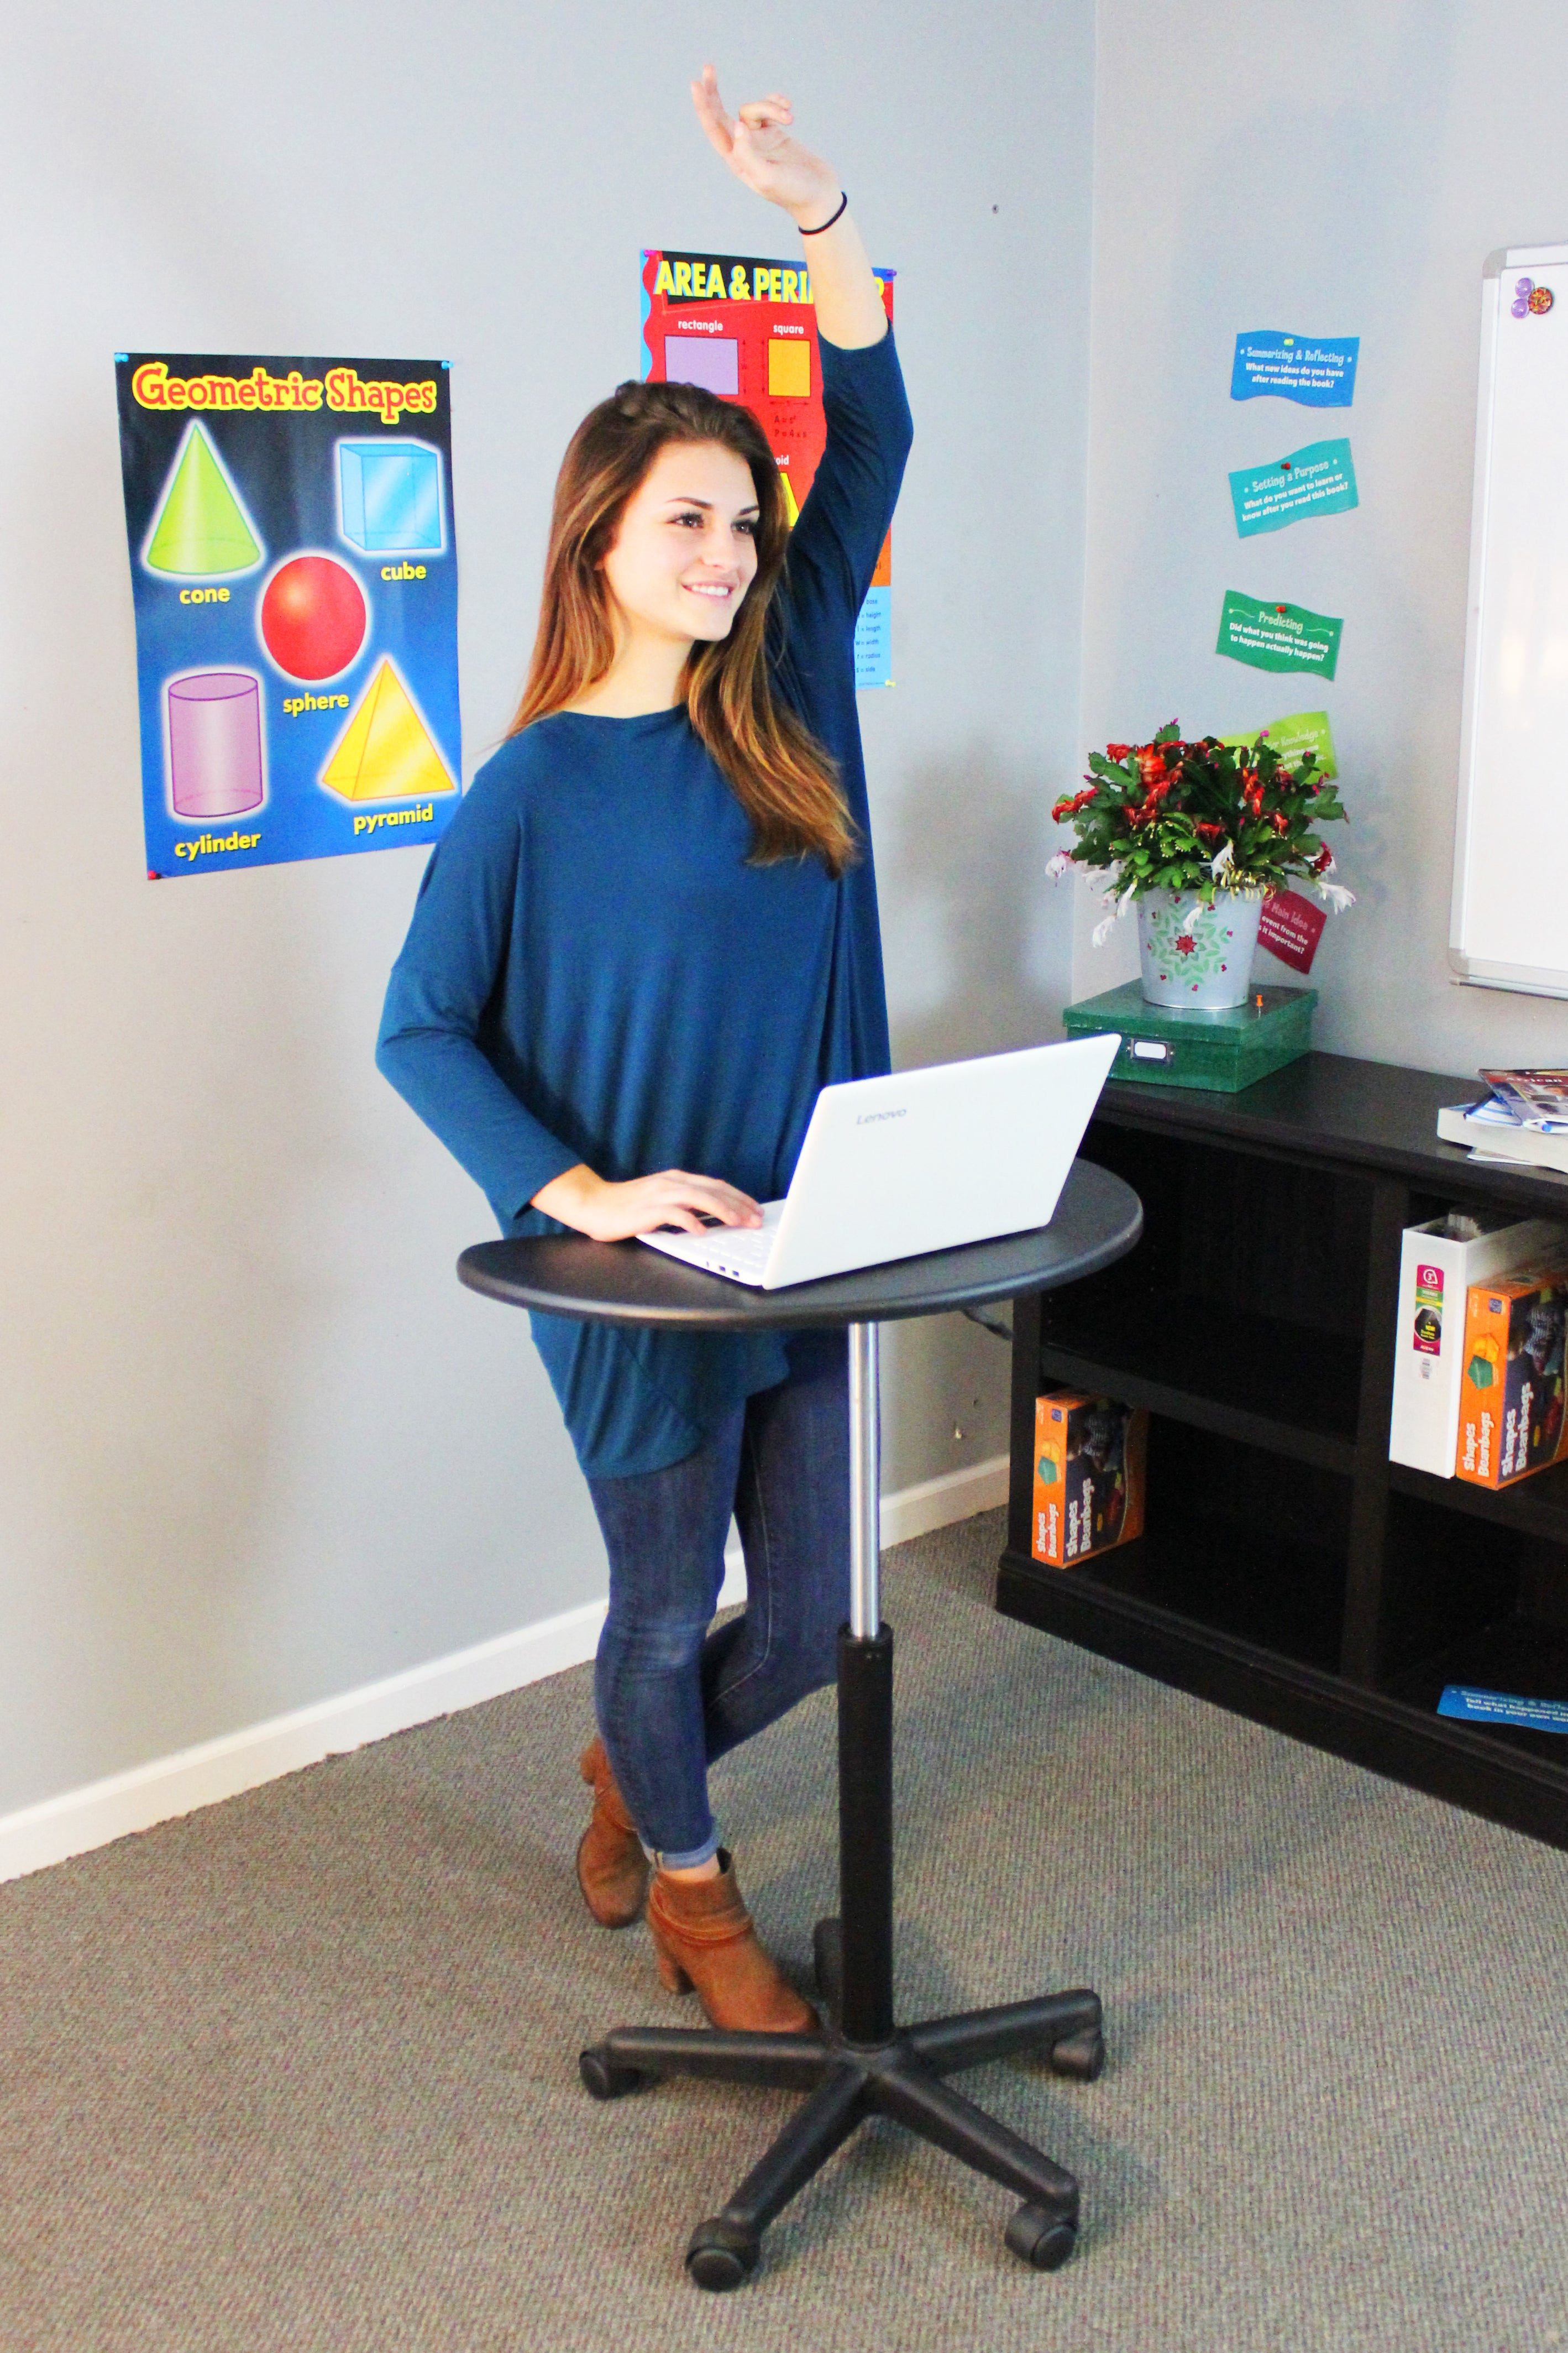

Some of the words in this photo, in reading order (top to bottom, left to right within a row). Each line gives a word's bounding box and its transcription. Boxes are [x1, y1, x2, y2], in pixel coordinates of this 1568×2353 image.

[653, 261, 727, 300] AREA
[729, 265, 752, 301] &
[678, 320, 723, 333] rectangle
[773, 324, 804, 336] square
[1246, 363, 1264, 372] What
[1281, 365, 1299, 375] ideas
[1300, 367, 1309, 375] do
[1311, 369, 1325, 377] you
[1326, 368, 1344, 377] have
[1247, 346, 1294, 363] Summarizing
[1296, 350, 1302, 360] &
[1305, 350, 1344, 367] Reflecting
[133, 362, 323, 410] Geometric
[325, 368, 436, 423] Shapes
[1252, 374, 1269, 384] after
[1270, 376, 1298, 387] reading
[1299, 378, 1310, 386] the
[1312, 379, 1334, 388] book?
[1252, 474, 1285, 492] Setting
[1287, 473, 1293, 481] a
[1294, 461, 1329, 479] Purpose
[1242, 510, 1261, 522] know
[1262, 504, 1279, 515] after
[1281, 501, 1294, 511] you
[1294, 495, 1311, 505] read
[1312, 489, 1325, 499] this
[1326, 482, 1348, 495] book?
[1244, 499, 1262, 510] What
[1263, 495, 1273, 504] do
[1274, 491, 1287, 502] you
[1288, 487, 1305, 496] want
[1307, 482, 1314, 490] to
[1315, 476, 1334, 488] learn
[380, 562, 427, 581] cube
[180, 587, 230, 604] cone
[1229, 623, 1242, 632] Did
[1242, 625, 1260, 636] what
[1261, 630, 1274, 639] you
[1275, 632, 1293, 643] think
[1294, 637, 1308, 646] was
[1309, 641, 1329, 653] going
[1258, 611, 1303, 635] Predicting
[1239, 636, 1265, 649] happen
[1265, 640, 1294, 656] actually
[1294, 648, 1324, 661] happen?
[282, 692, 350, 717] sphere
[353, 803, 433, 834] pyramid
[174, 832, 261, 861] cylinder
[1261, 916, 1279, 930] event
[1281, 924, 1296, 939] from
[1297, 934, 1308, 945] the
[1271, 902, 1289, 920] Main
[1291, 911, 1308, 930] Idea
[1268, 929, 1304, 954] important?
[1515, 1382, 1534, 1472] Beanbags
[1462, 1423, 1478, 1472] Shapes
[1477, 1411, 1494, 1477] Beanbags
[1501, 1409, 1518, 1477] Shapes
[1066, 1500, 1081, 1557] Shapes
[1080, 1477, 1095, 1553] Beanbags
[1036, 1512, 1049, 1554] Shapes
[1047, 1503, 1059, 1559] Beanbags
